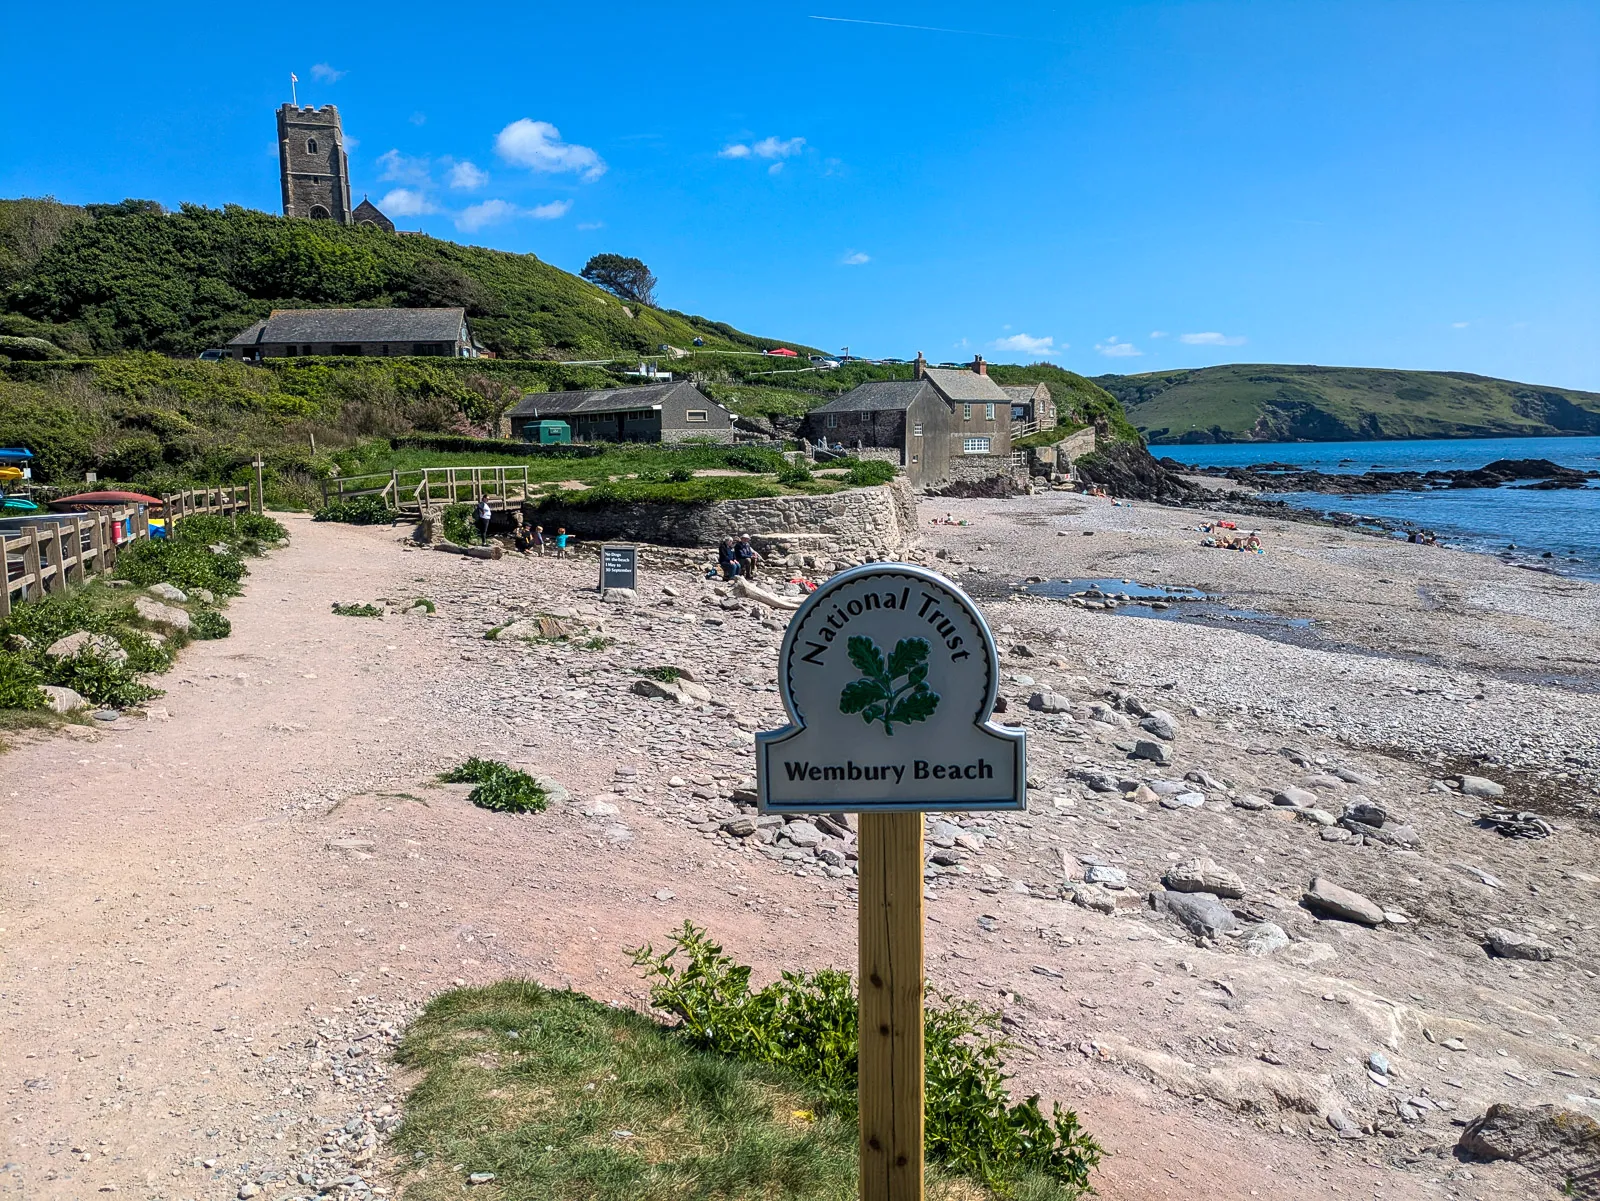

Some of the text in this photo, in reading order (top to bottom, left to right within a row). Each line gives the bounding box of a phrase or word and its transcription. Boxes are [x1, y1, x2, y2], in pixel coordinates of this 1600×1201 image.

[801, 587, 971, 666] National Trust
[784, 758, 993, 784] Wembury Beach
